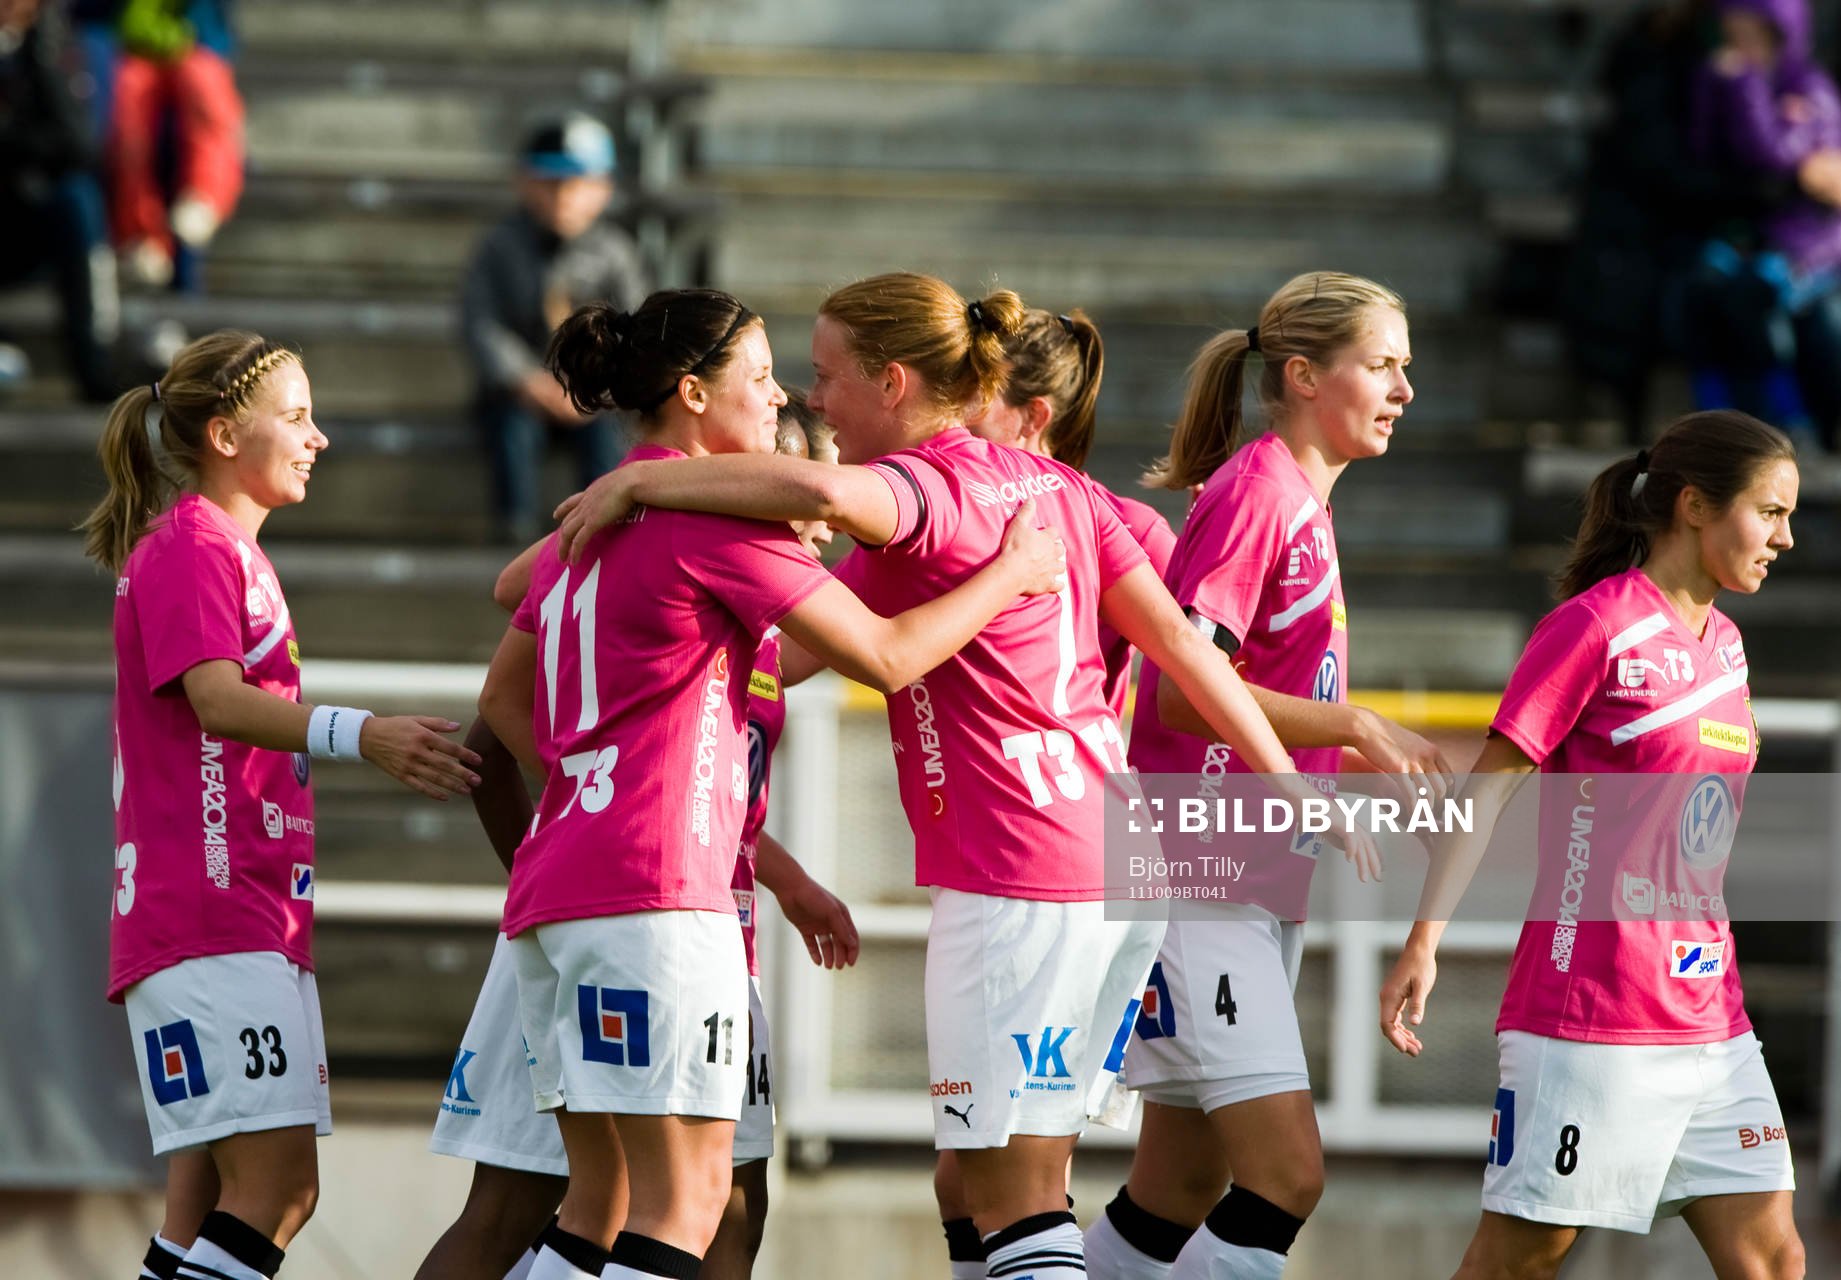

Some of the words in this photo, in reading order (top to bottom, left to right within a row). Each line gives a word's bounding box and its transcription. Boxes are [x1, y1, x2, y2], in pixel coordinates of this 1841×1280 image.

[539, 557, 600, 741] 11
[1663, 648, 1695, 682] T3
[1606, 688, 1629, 698] UMEÅ
[1630, 689, 1658, 697] ENERGI
[558, 745, 619, 820] T3
[1000, 729, 1086, 809] T3
[1215, 973, 1237, 1026] 4
[239, 1025, 288, 1080] 33
[704, 1011, 735, 1067] 11
[1010, 1026, 1078, 1078] VK
[747, 1053, 770, 1106] 14
[1555, 1124, 1580, 1176] 8
